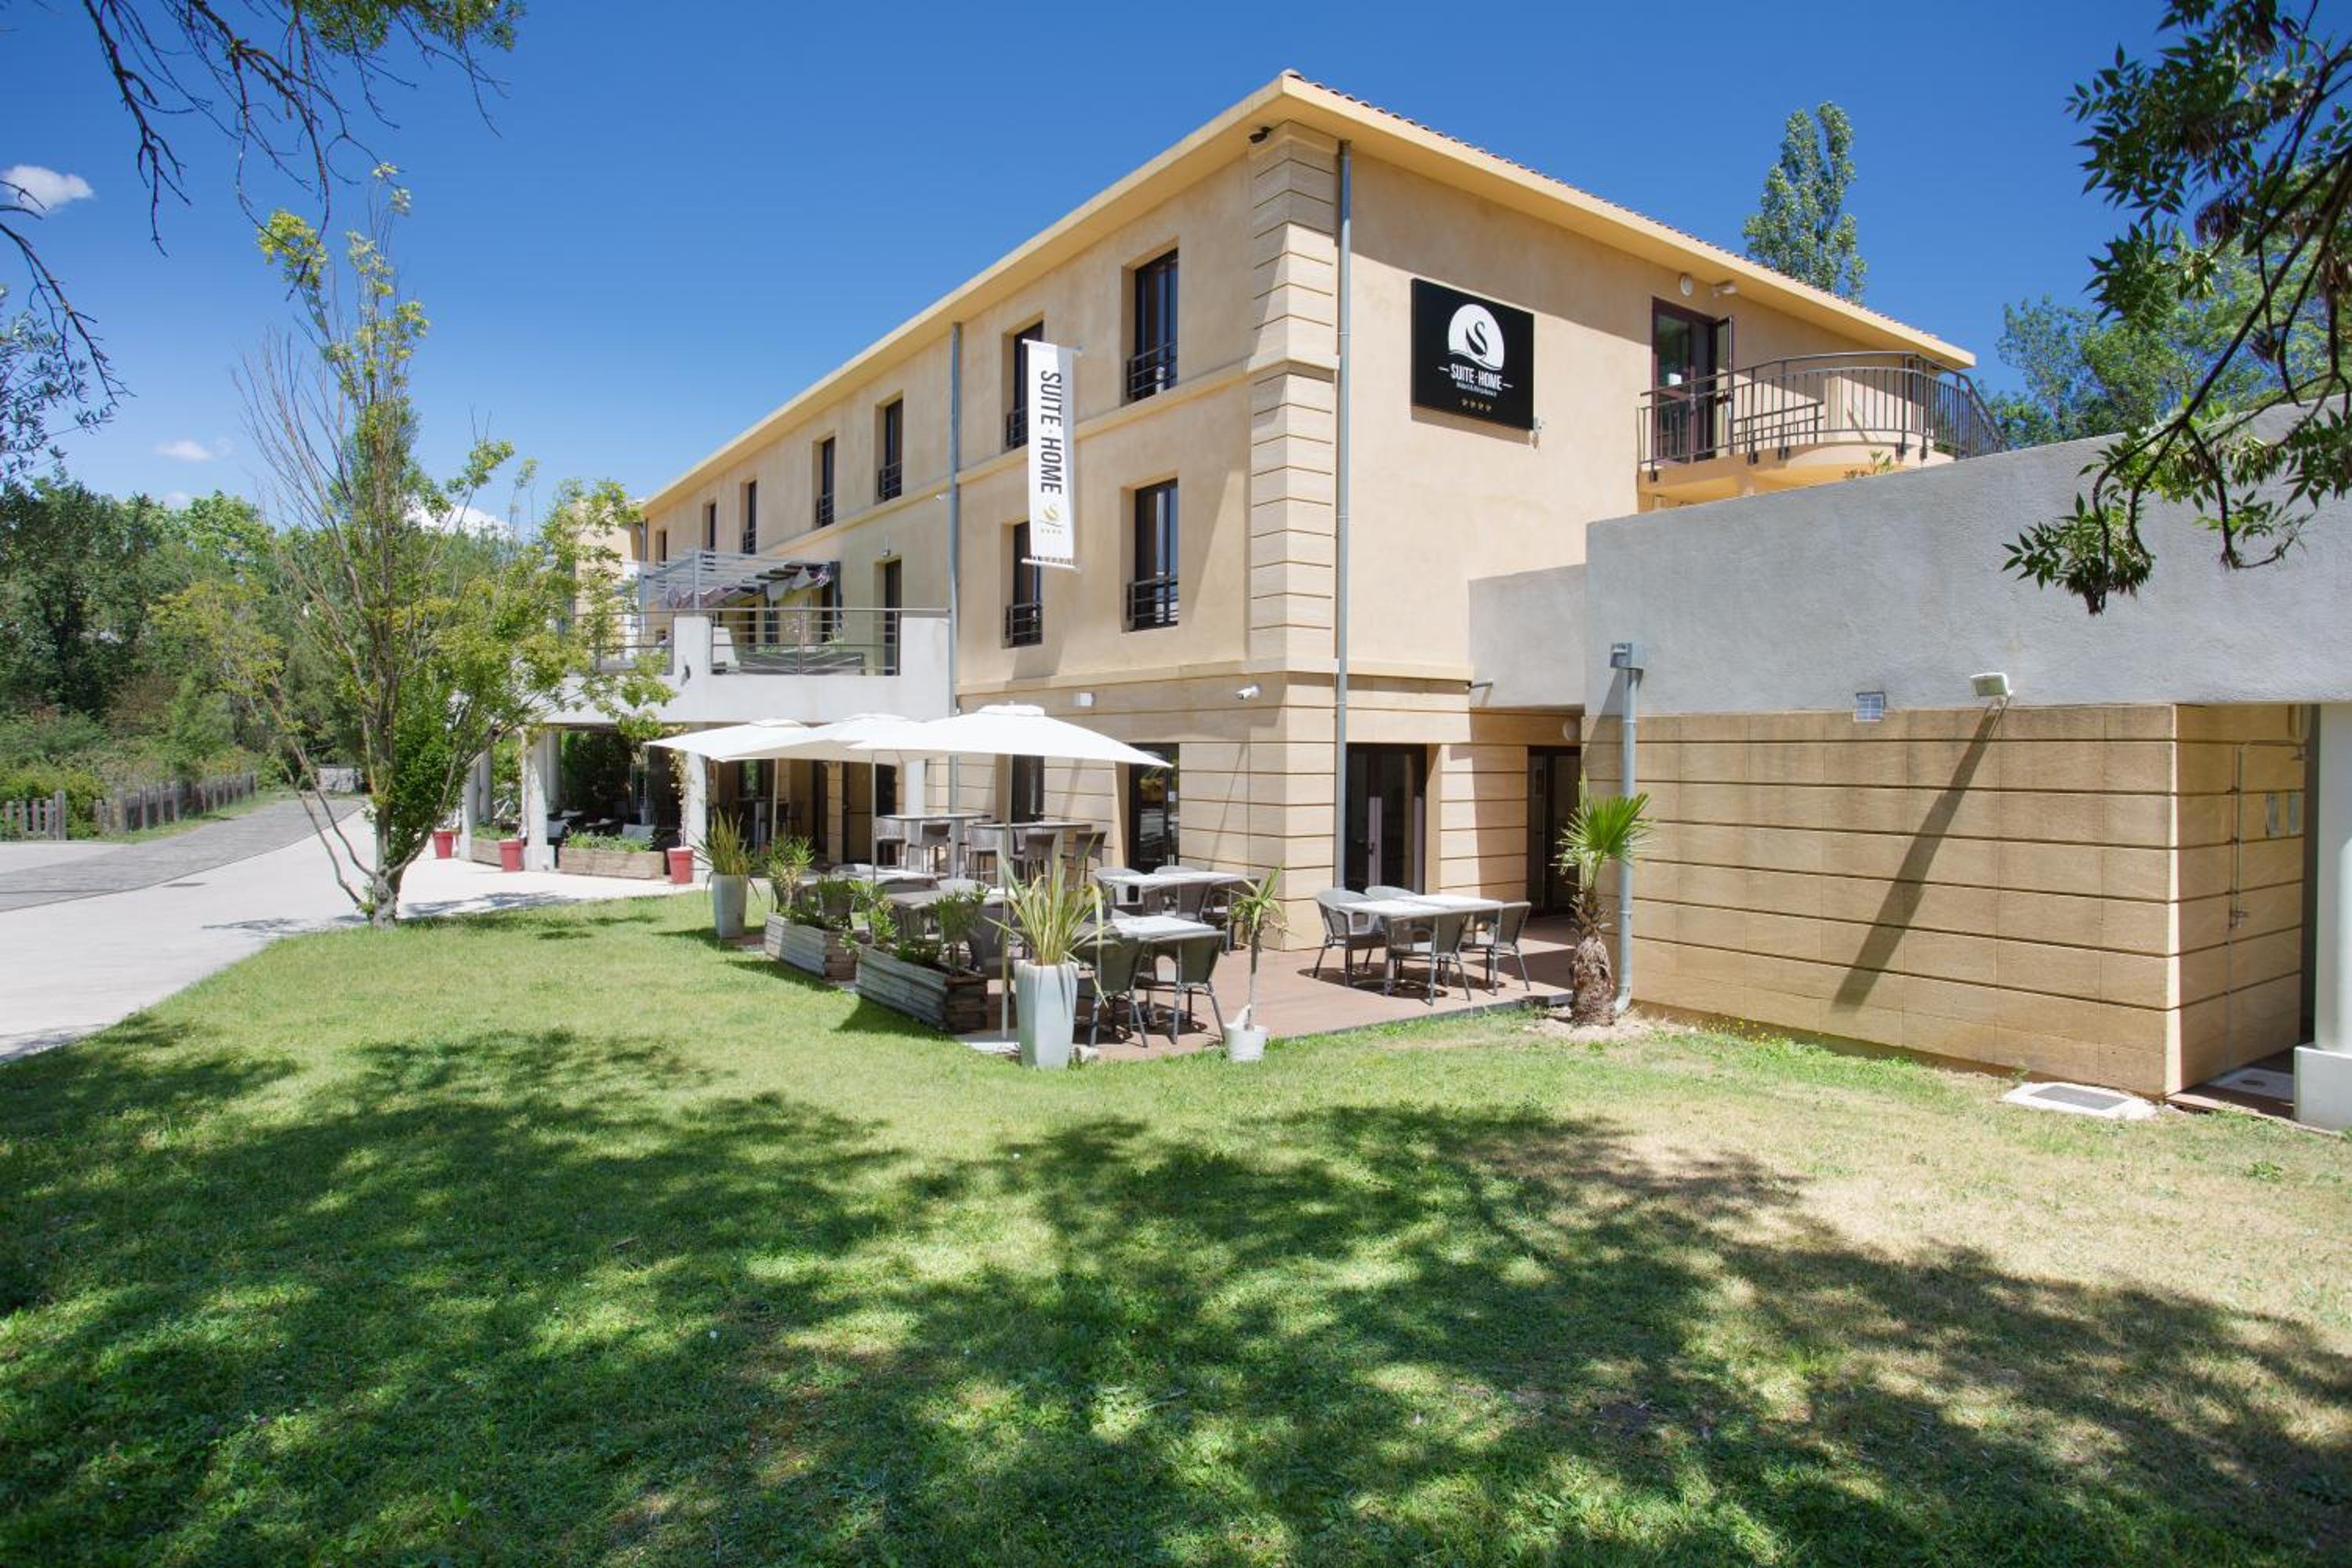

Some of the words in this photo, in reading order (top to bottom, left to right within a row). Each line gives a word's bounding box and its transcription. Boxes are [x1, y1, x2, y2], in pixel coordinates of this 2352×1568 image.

[1041, 370, 1062, 426] SUITE
[1450, 363, 1474, 383] SUITE
[1478, 370, 1502, 390] HOME
[1041, 437, 1062, 494] HOME
